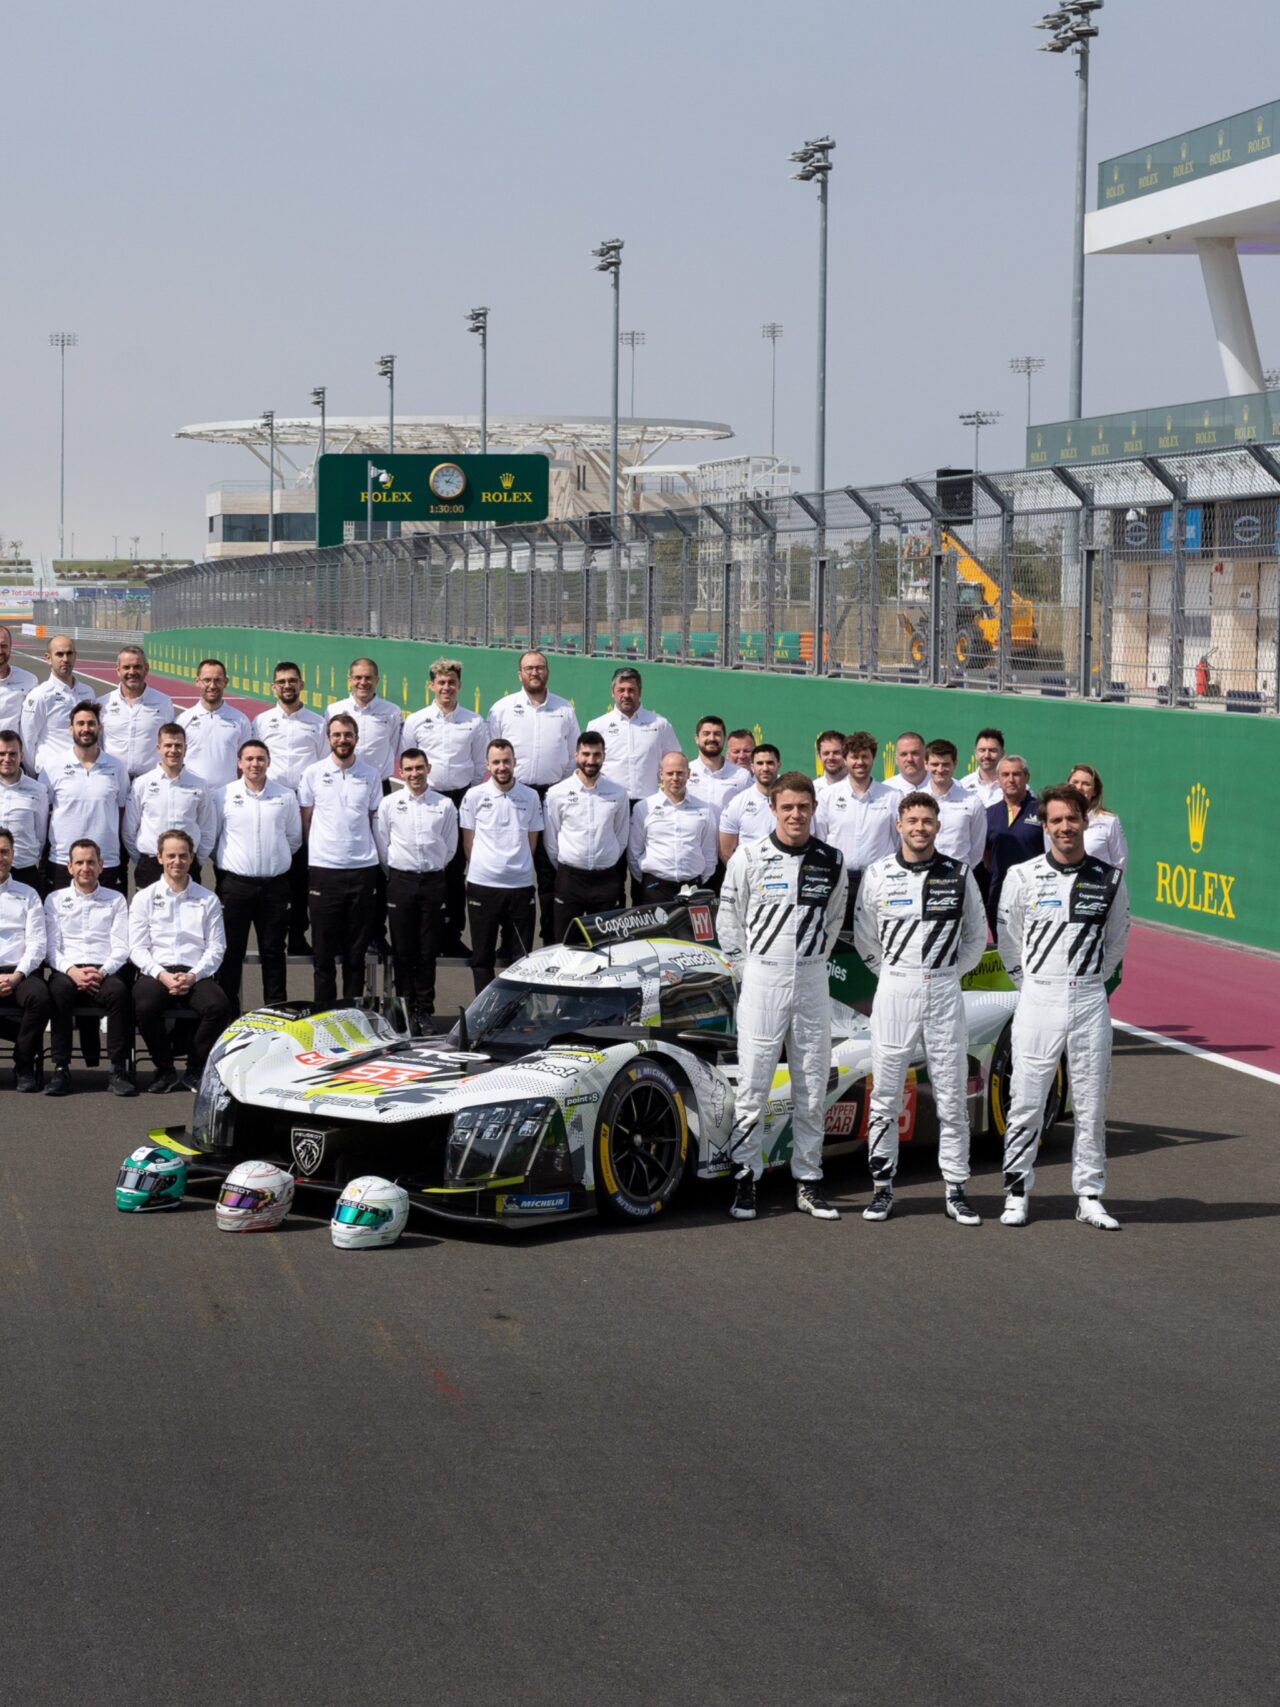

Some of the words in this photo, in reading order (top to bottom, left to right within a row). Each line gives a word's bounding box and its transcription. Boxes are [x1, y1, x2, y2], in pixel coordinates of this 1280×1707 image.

[1248, 136, 1271, 154] ROLEX
[1209, 149, 1232, 166] ROLEX
[1173, 161, 1194, 177] ROLEX
[1139, 173, 1159, 189] ROLEX
[1106, 184, 1125, 199] ROLEX
[360, 492, 412, 503] ROLEX
[481, 492, 532, 503] ROLEX
[429, 505, 464, 513] 1:30:00
[1156, 861, 1235, 919] ROLEX
[926, 897, 959, 906] WEC
[1075, 901, 1108, 910] WEC
[595, 909, 656, 937] Capgemini
[692, 912, 711, 934] HY
[669, 951, 717, 971] yahoo!
[342, 1064, 415, 1085] 93
[513, 1062, 579, 1078] yahoo!
[259, 1087, 398, 1112] PEUGEOT
[566, 1096, 588, 1105] point
[826, 1104, 855, 1116] HYPER
[825, 1116, 852, 1132] CAR
[521, 1198, 566, 1209] MICHELIN
